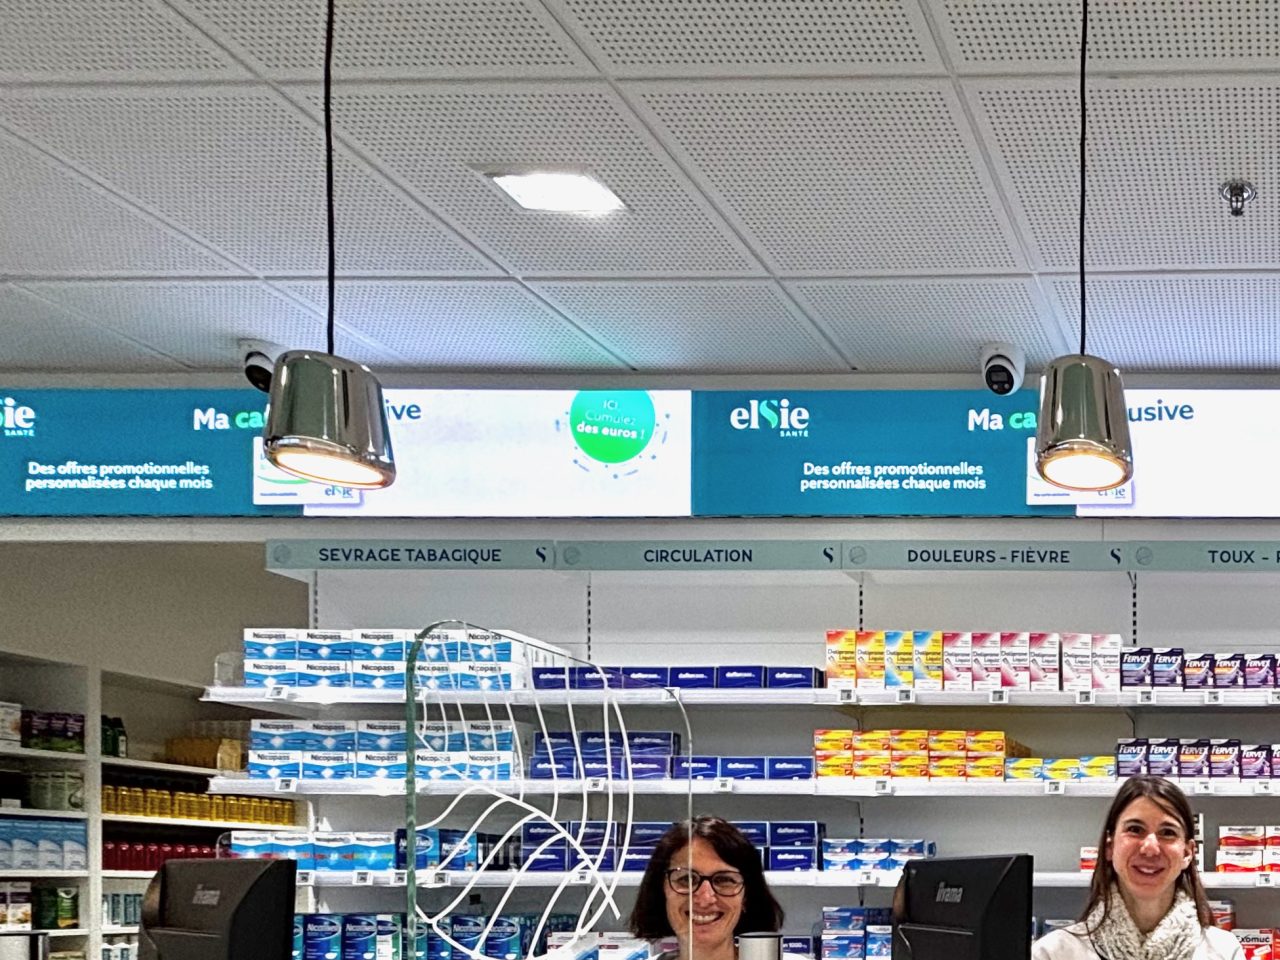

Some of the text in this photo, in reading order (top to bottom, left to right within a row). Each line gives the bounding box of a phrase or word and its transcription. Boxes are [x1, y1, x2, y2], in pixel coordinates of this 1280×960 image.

[193, 408, 230, 430] Ma
[967, 408, 1004, 431] Ma
[576, 422, 600, 434] des
[601, 425, 638, 439] euros
[28, 461, 210, 477] Des offres promotionnelles
[803, 461, 984, 477] Des offres promotionnelles
[25, 476, 213, 491] personnalisées chaque mois
[800, 476, 987, 492] personnalisées chaque mois
[318, 547, 502, 564] SEVRAGE TABAGIQUE
[643, 549, 753, 563] CIRCULATION
[907, 545, 1070, 564] DOULEURS FIÈVRE
[1207, 550, 1255, 564] TOUX
